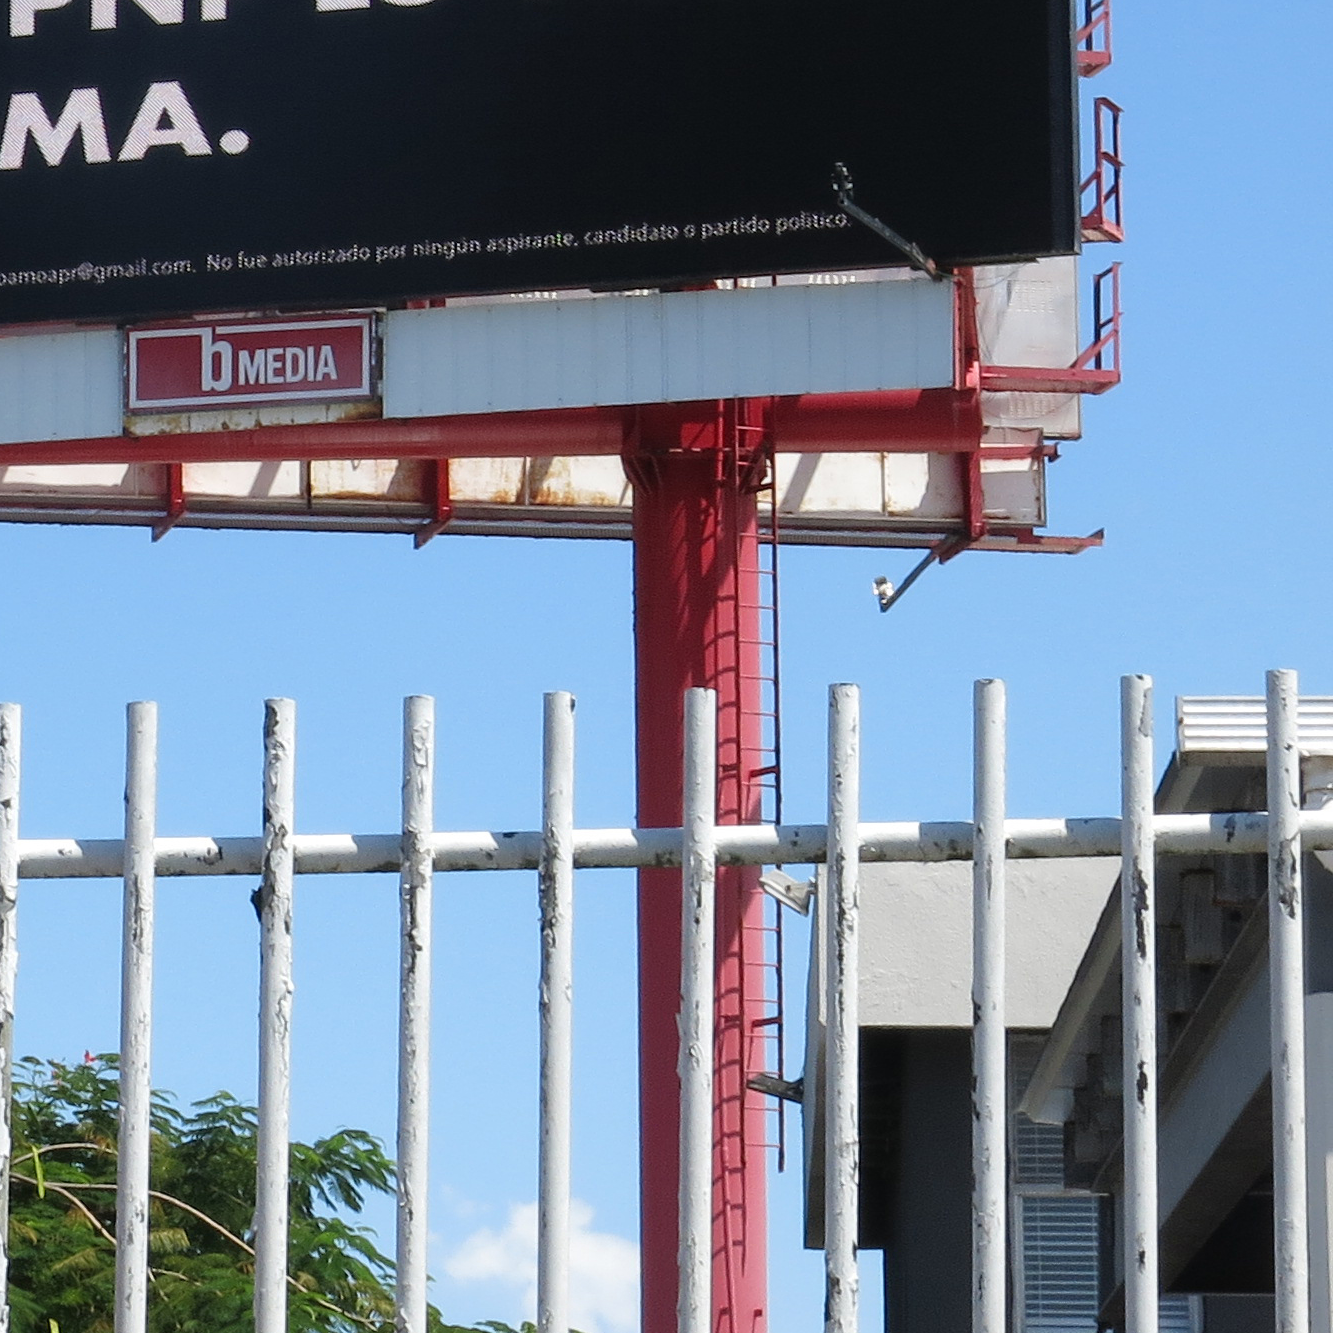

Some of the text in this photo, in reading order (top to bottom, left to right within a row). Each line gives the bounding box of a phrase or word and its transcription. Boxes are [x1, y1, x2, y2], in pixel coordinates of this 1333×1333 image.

[206, 252, 233, 272] No
[236, 250, 268, 269] fue
[270, 243, 372, 268] autorizado
[375, 243, 407, 265] por
[485, 230, 580, 256] aspirante,
[583, 221, 680, 246] candidato
[683, 223, 695, 239] o
[700, 215, 770, 242] partido
